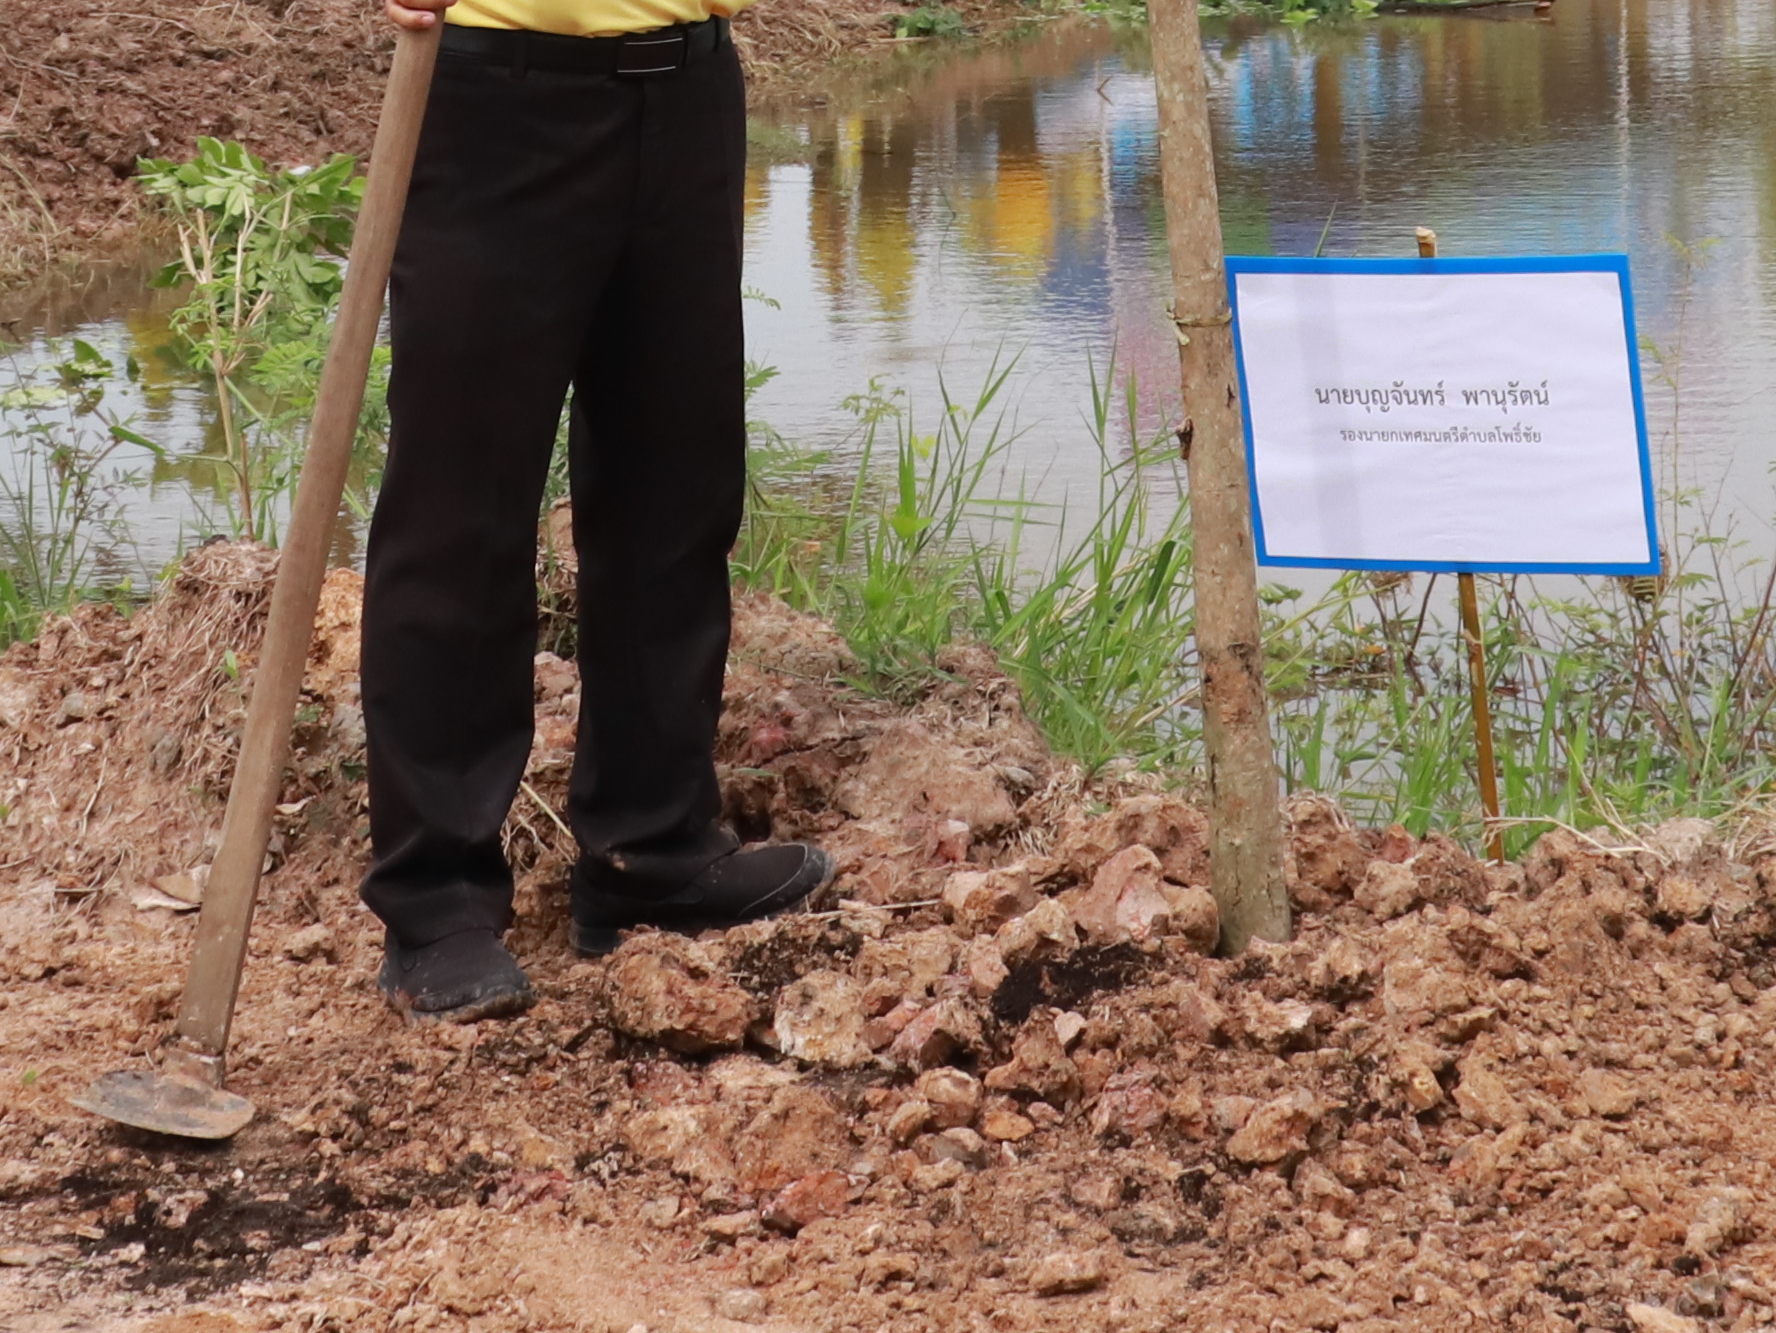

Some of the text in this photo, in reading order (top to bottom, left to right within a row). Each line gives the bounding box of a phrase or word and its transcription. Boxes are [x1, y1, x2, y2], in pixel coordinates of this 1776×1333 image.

[1314, 379, 1551, 414] นายบุญจันทร์ พานุรัตน์
[1339, 421, 1542, 444] รองนายกเทศมนตรีตำบลโพธิ์ชัย
